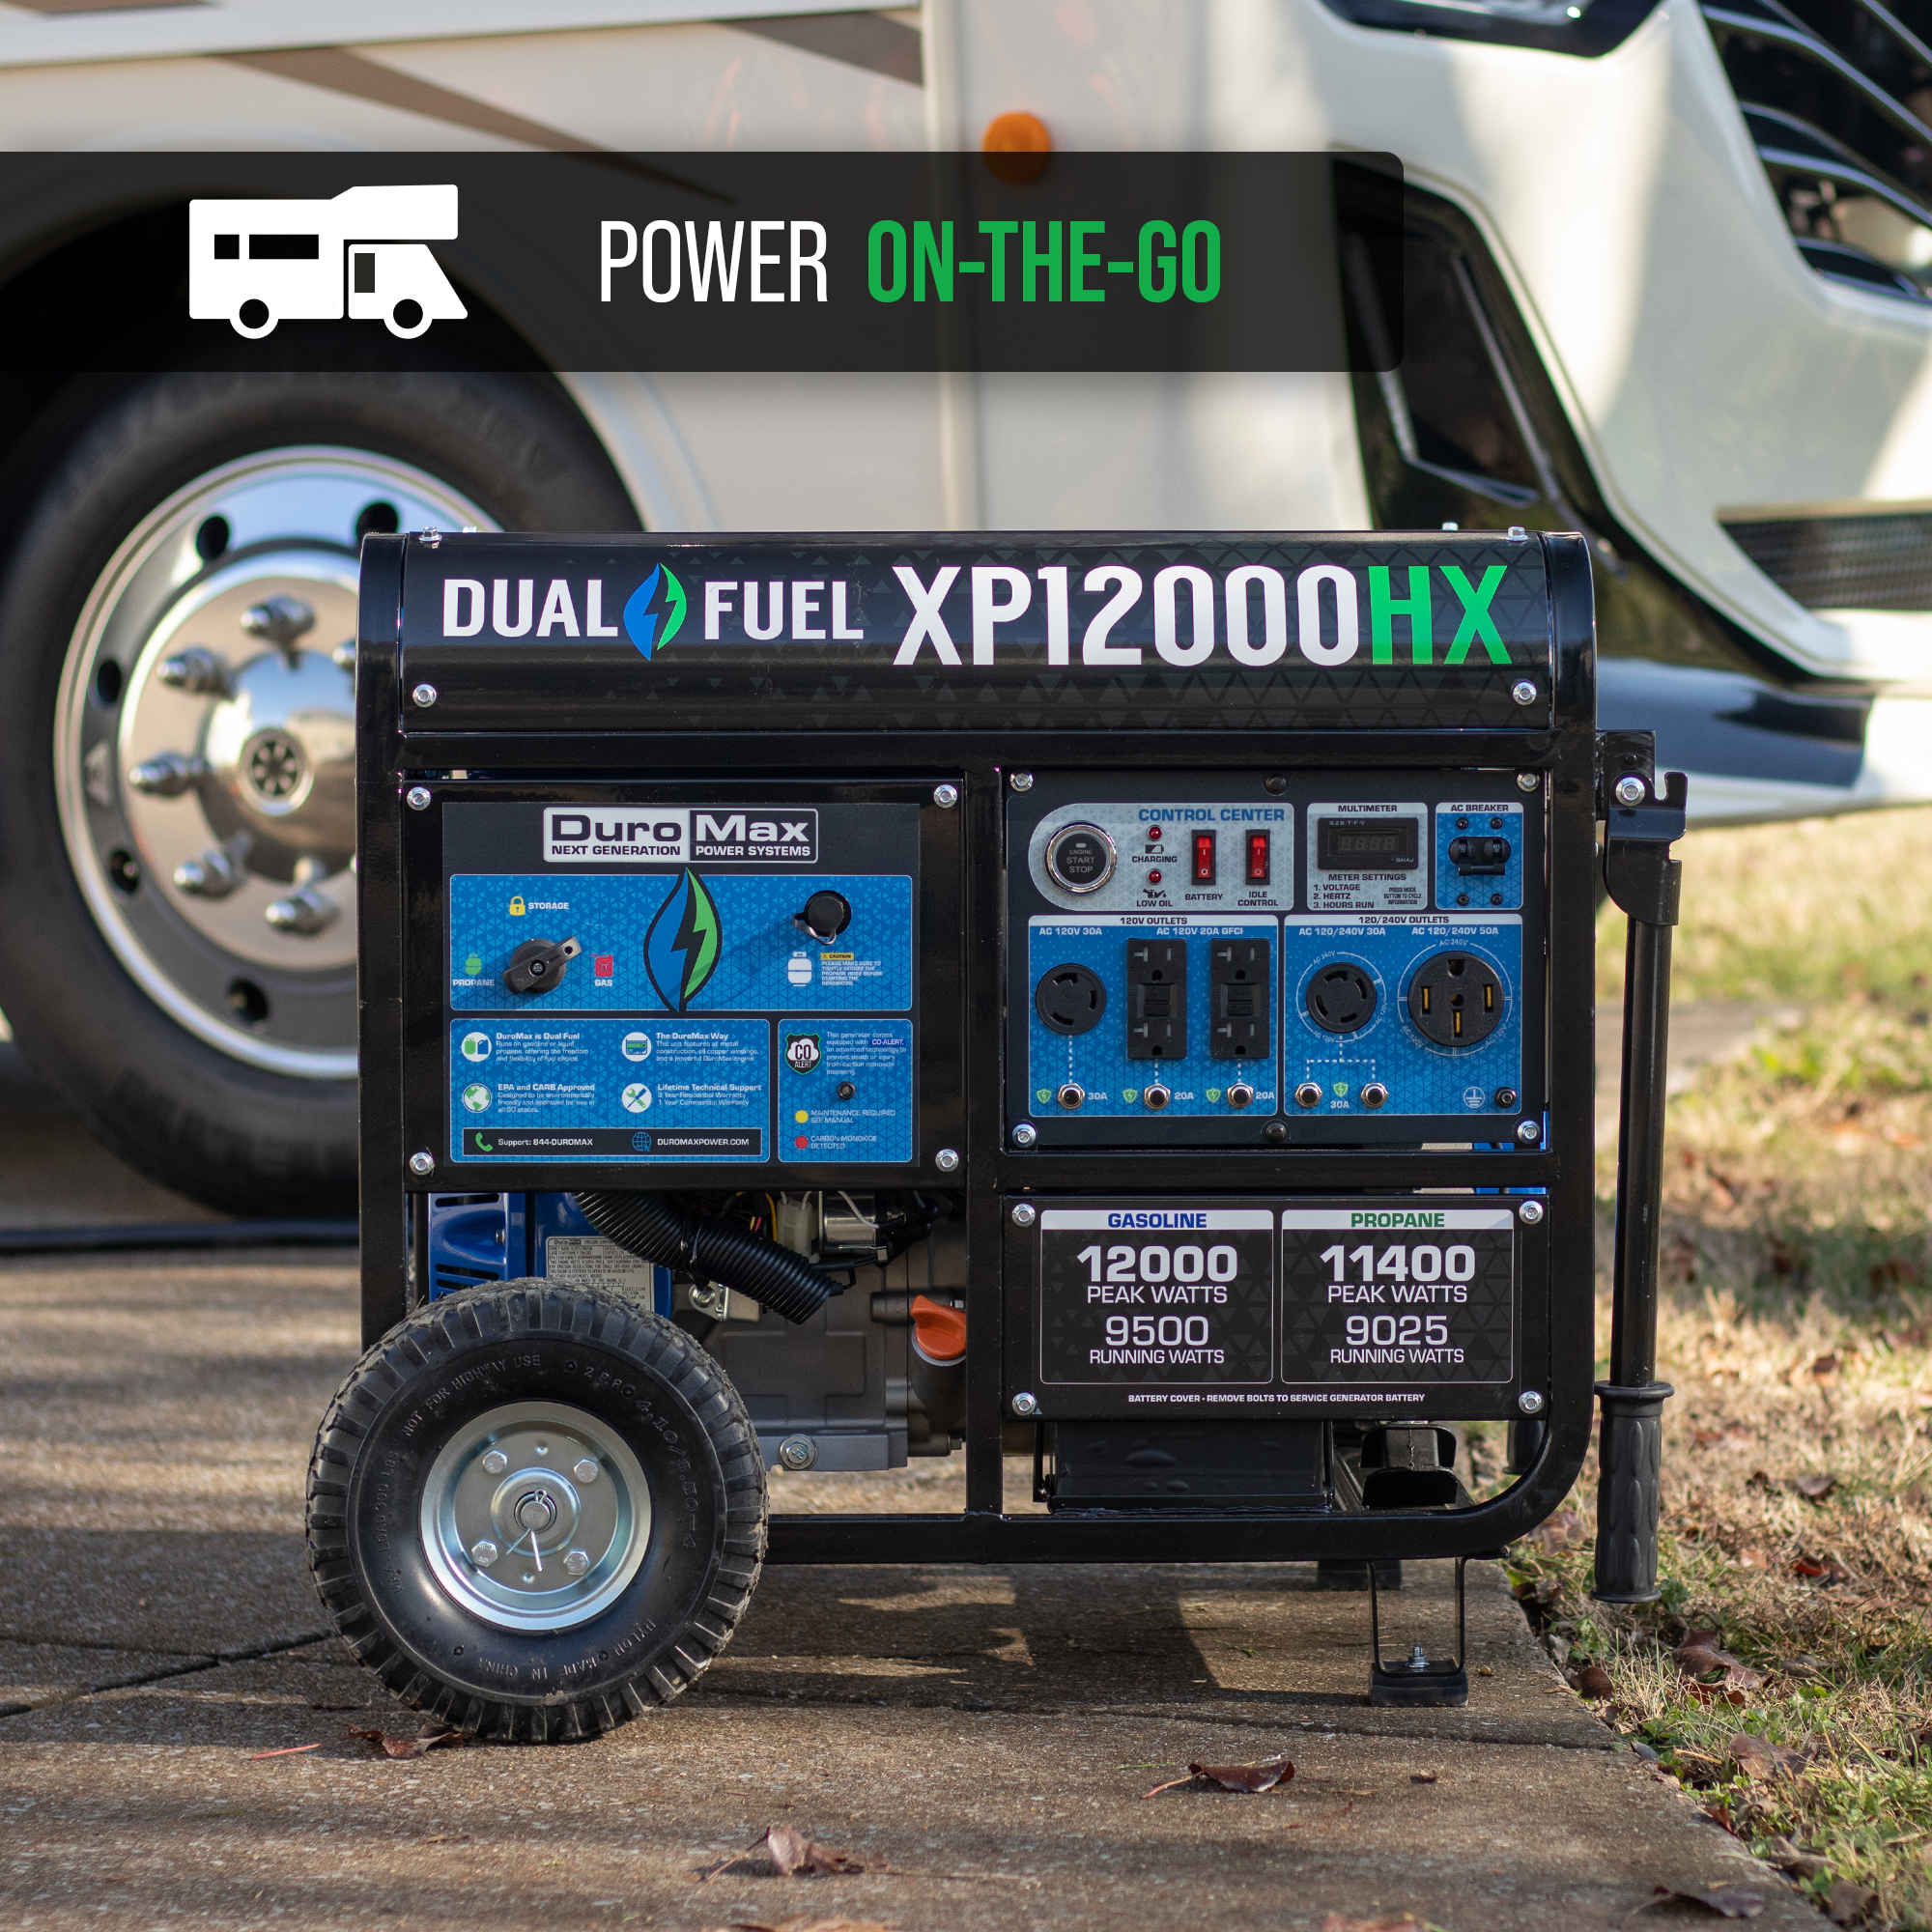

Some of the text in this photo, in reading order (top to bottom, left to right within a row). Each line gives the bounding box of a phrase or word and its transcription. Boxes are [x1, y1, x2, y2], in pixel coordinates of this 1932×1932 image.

[442, 564, 1513, 667] DUAL FUEL XP12000HX
[1138, 809, 1285, 822] CONTROL CENTER
[552, 814, 810, 842] Duro Max
[552, 845, 681, 856] NEXT GENERATION
[696, 846, 810, 857] POWER SYSTEMS
[1131, 855, 1178, 864] CHARGING
[1358, 916, 1407, 924] 120/240V
[1298, 927, 1313, 936] AC
[1315, 927, 1365, 937] 120/240V
[1427, 927, 1477, 936] 120/240V
[1312, 951, 1336, 965] AC 240V
[594, 979, 612, 987] GAS
[1375, 1002, 1388, 1025] AC 120V
[710, 1032, 728, 1040] Way
[1312, 1030, 1336, 1043] AC 120V
[1403, 1025, 1410, 1036] AC
[1409, 1032, 1424, 1048] 120V
[1486, 1037, 1494, 1047] AC
[1494, 1025, 1507, 1039] 120V
[795, 1043, 811, 1061] CO
[1330, 1100, 1350, 1109] 30A
[497, 1138, 532, 1147] Support:
[1108, 1213, 1208, 1229] GASOLINE
[1350, 1212, 1445, 1228] PROPANE
[1076, 1245, 1237, 1283] 12000
[1320, 1245, 1476, 1282] 11400
[1087, 1286, 1228, 1303] PEAK WATTS
[1328, 1285, 1468, 1303] PEAK WATTS
[1105, 1316, 1209, 1346] 9500
[1346, 1315, 1448, 1346] 9025
[1090, 1350, 1225, 1364] RUNNING WATTS
[1331, 1349, 1464, 1363] RUNNING WATTS
[583, 1366, 594, 1378] 2
[401, 1354, 541, 1437] NOT FOR HIGHWAY USE
[613, 1619, 657, 1657] NYLON
[531, 1666, 548, 1680] IN
[559, 1656, 597, 1677] MADE
